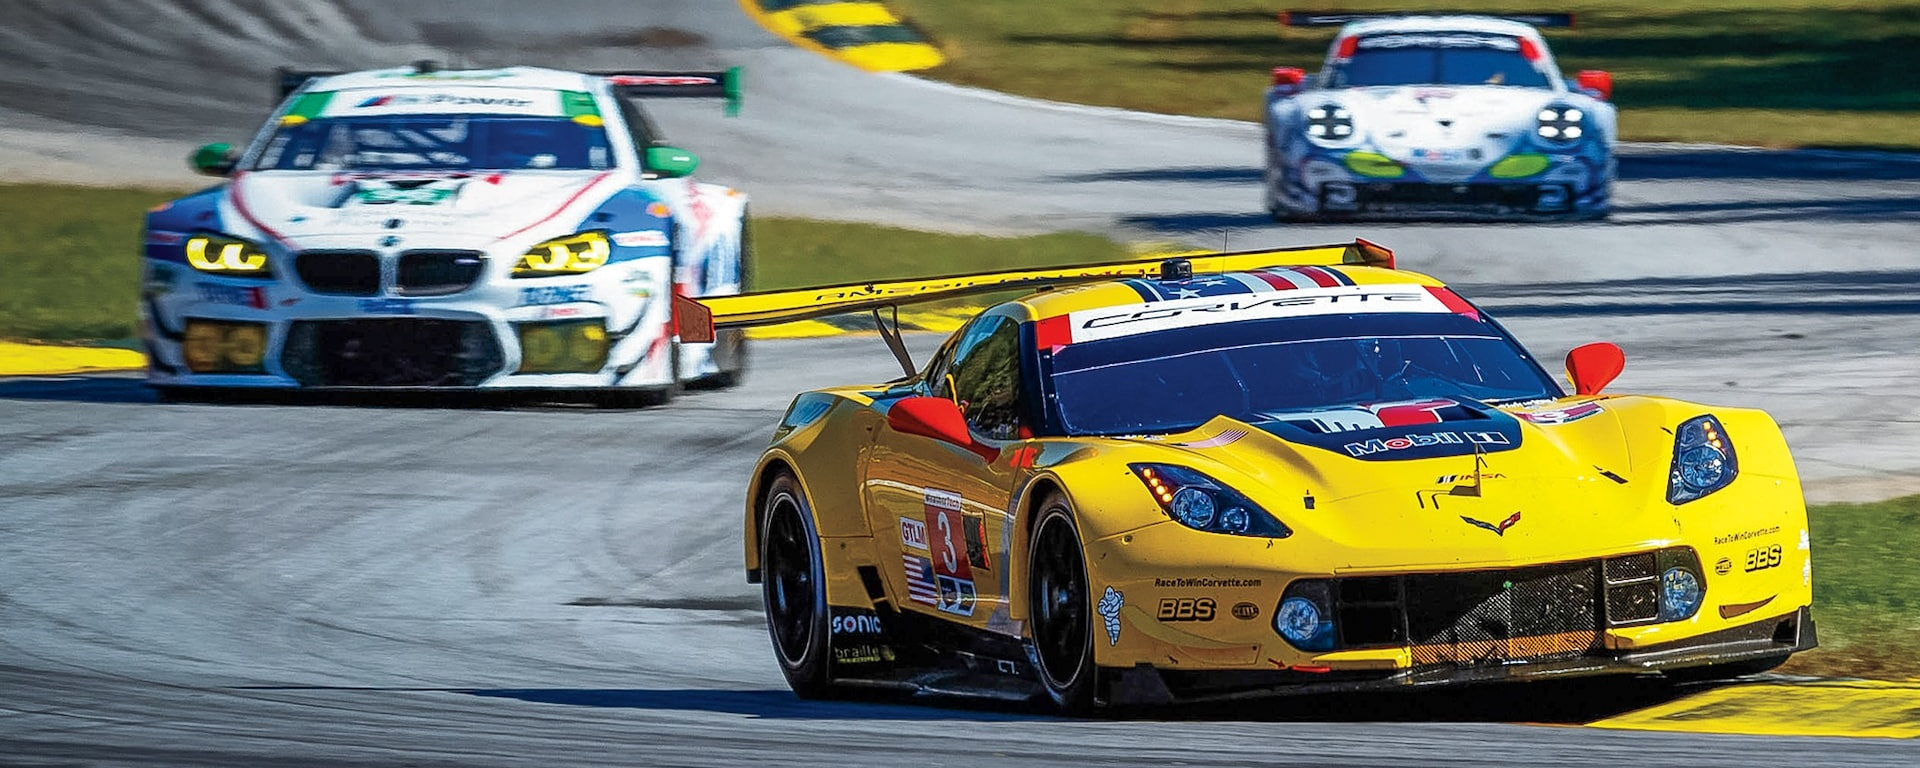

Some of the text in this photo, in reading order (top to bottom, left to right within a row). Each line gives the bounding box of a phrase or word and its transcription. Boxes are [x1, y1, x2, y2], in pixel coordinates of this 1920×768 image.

[1082, 292, 1422, 329] CORVETTE
[1344, 431, 1464, 457] Mobil
[902, 521, 927, 545] GTLM
[937, 511, 957, 574] 3
[1744, 544, 1782, 573] BBS
[1155, 577, 1262, 587] RaceToWinCorvette.com
[1158, 598, 1217, 621] BBS
